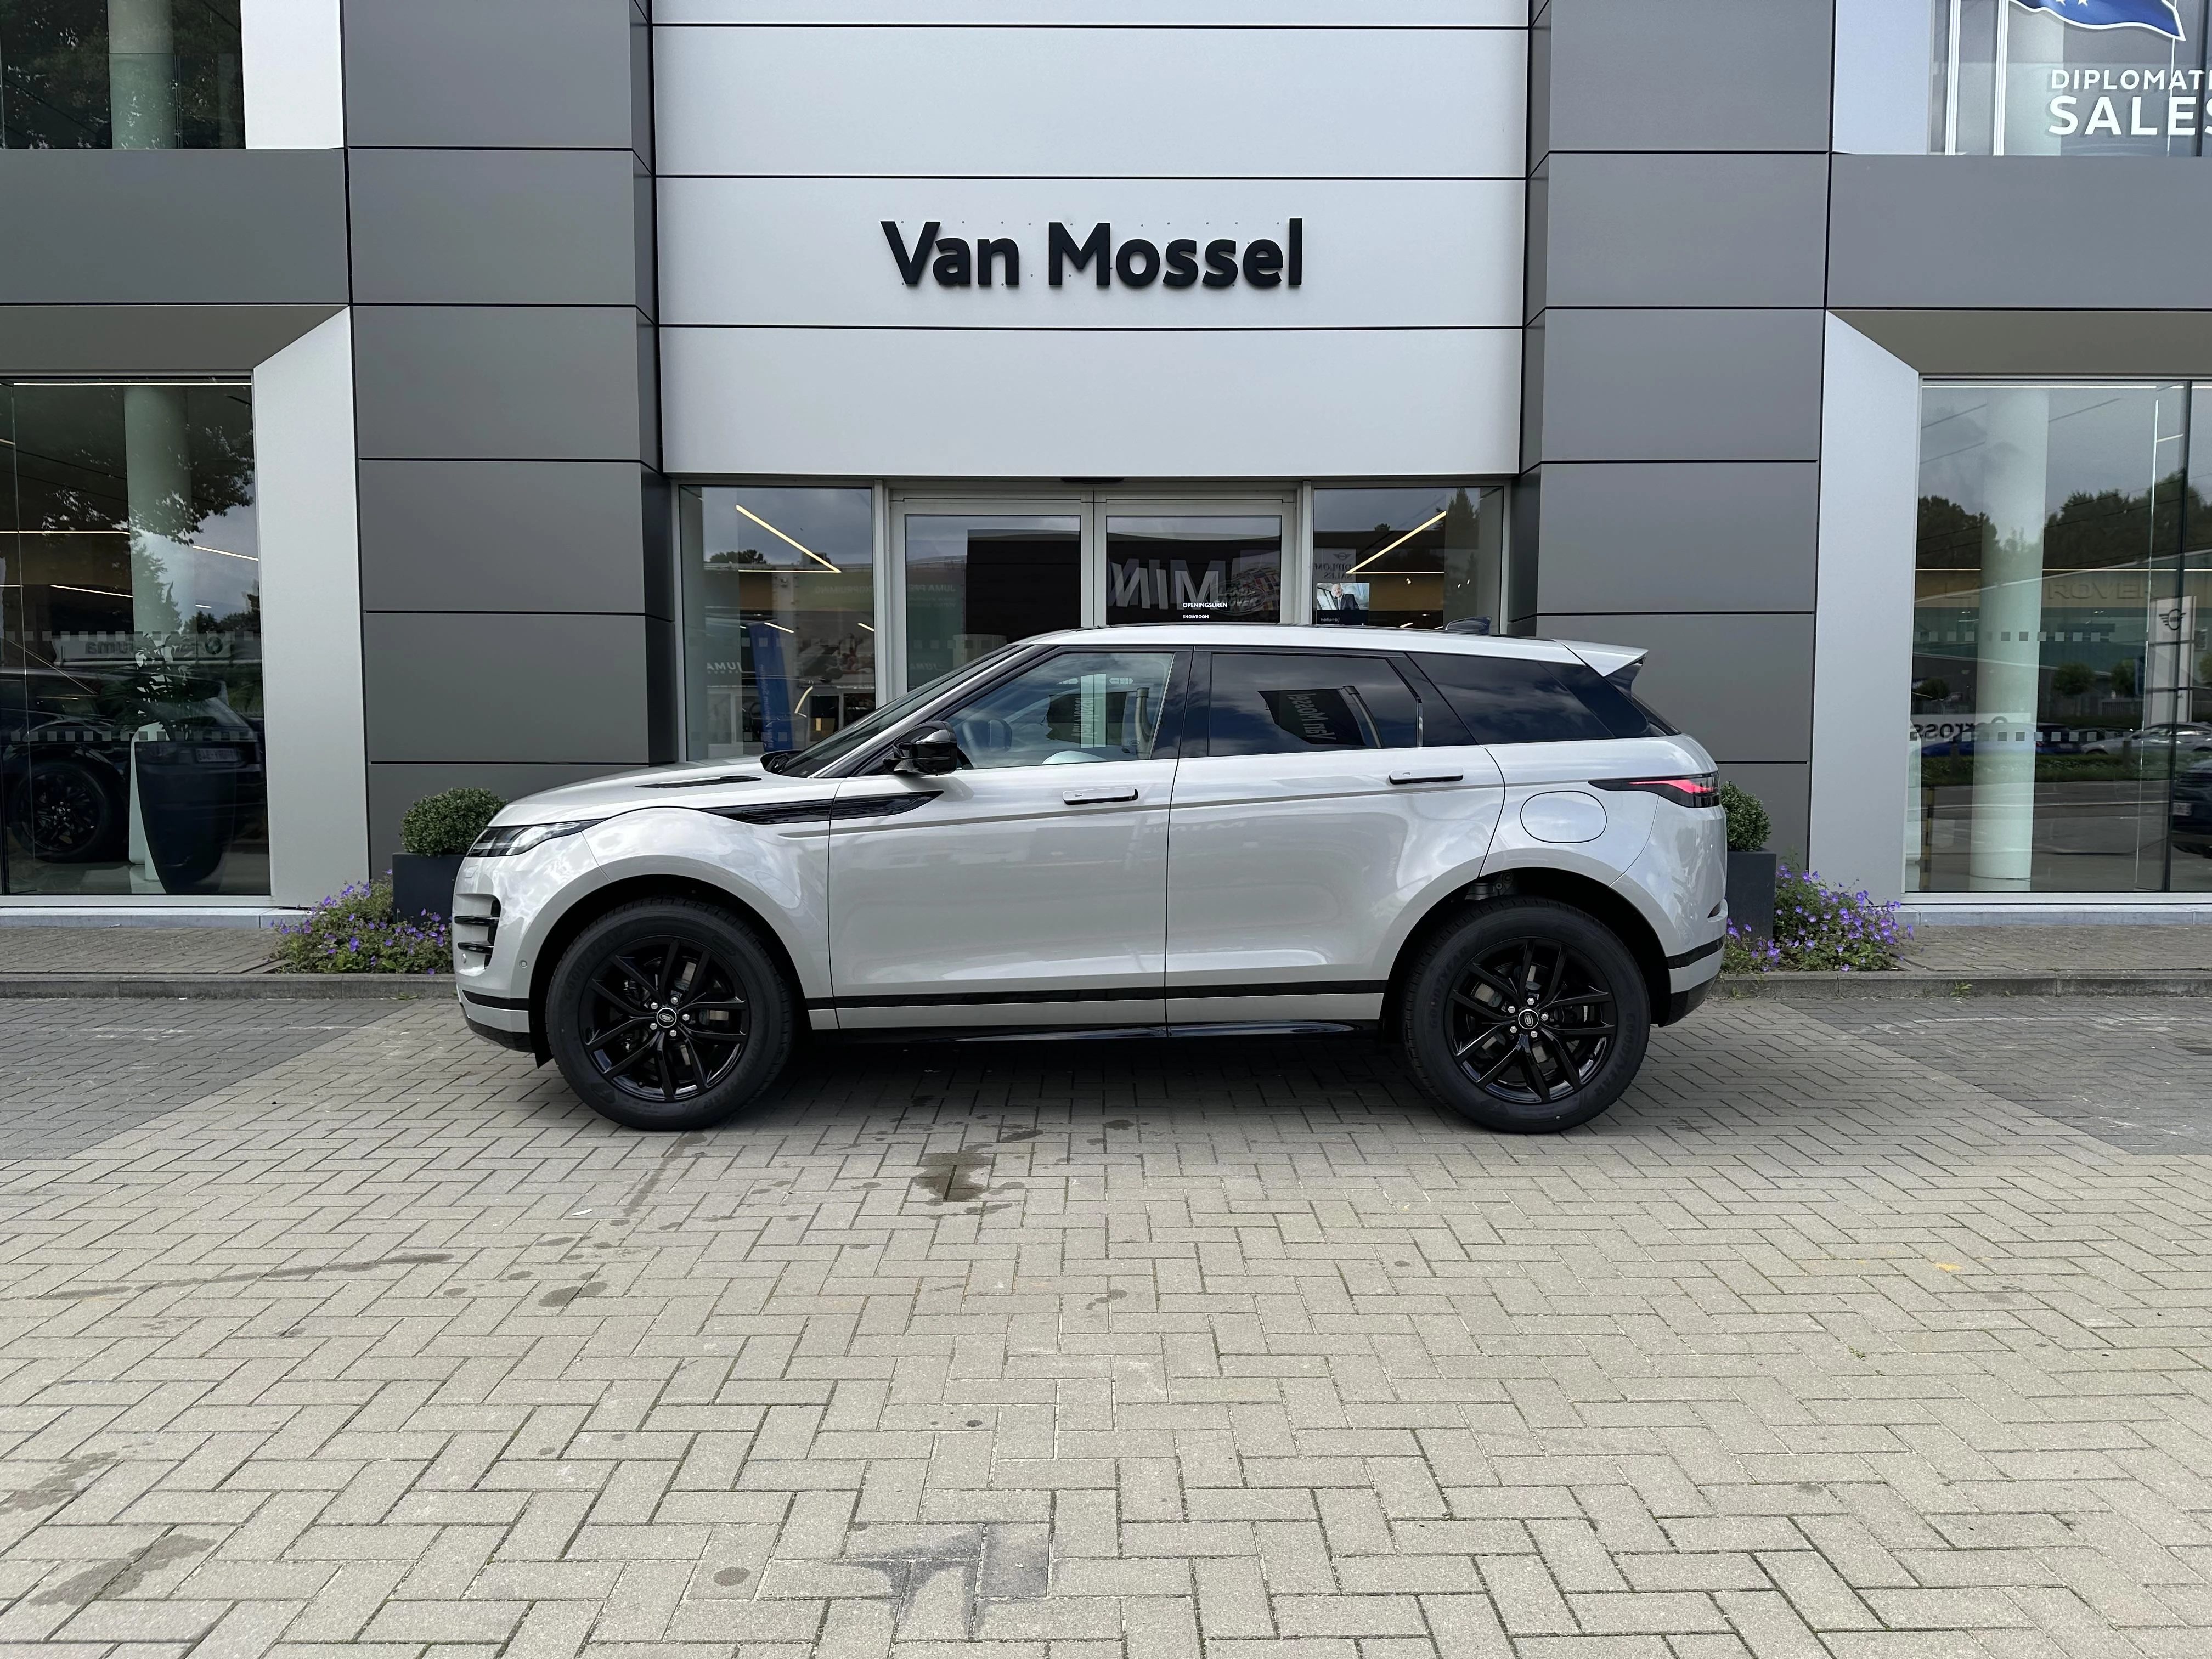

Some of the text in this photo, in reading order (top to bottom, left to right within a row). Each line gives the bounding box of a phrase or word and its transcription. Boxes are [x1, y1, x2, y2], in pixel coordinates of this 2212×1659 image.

[2049, 95, 2212, 136] SALE
[881, 218, 1303, 287] Van Mossel
